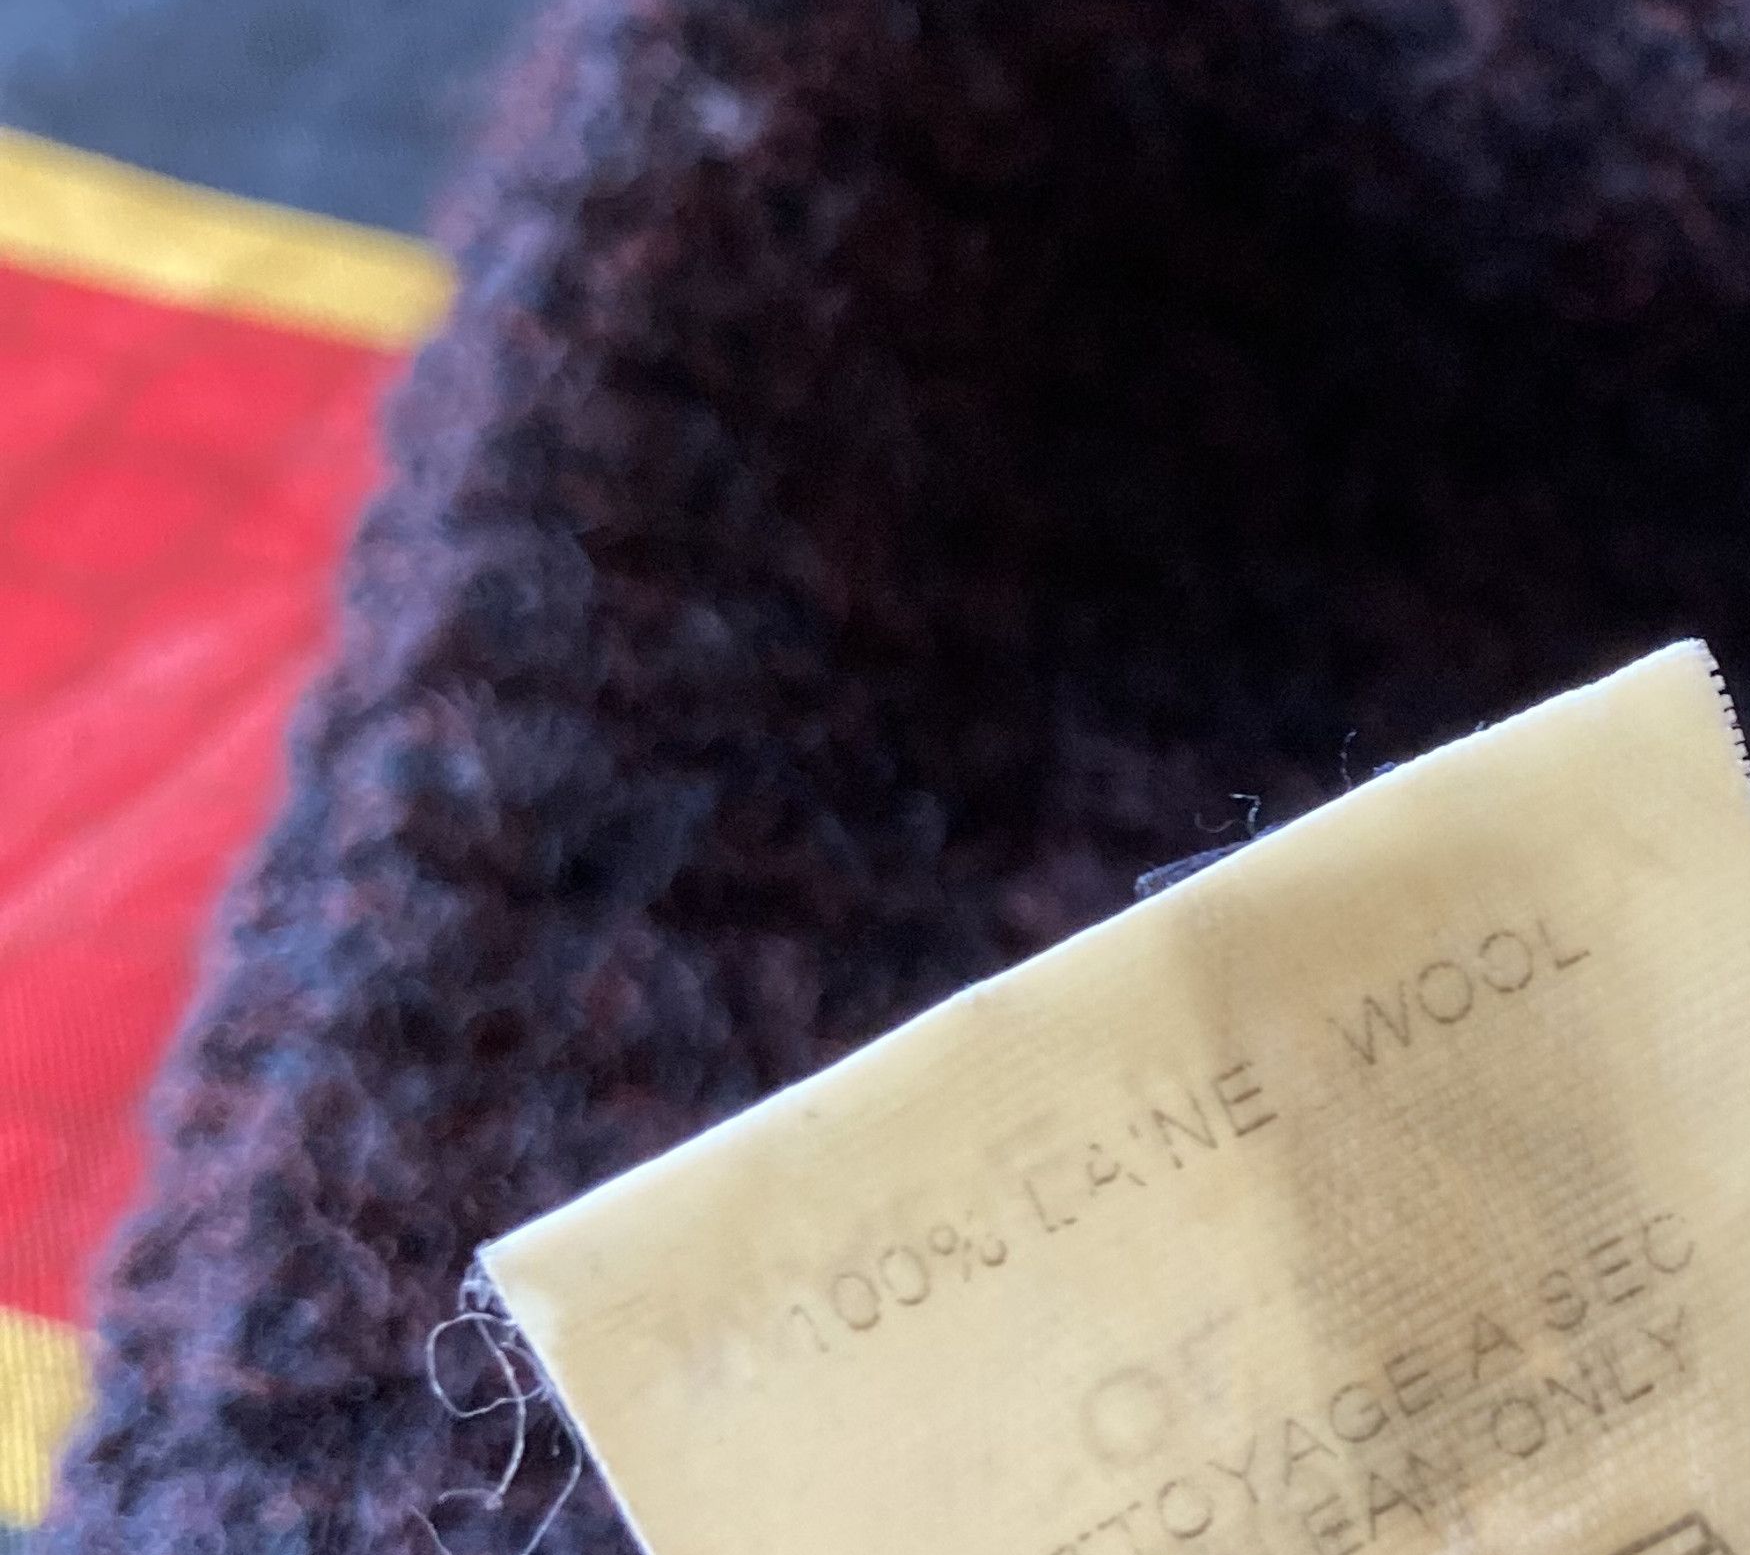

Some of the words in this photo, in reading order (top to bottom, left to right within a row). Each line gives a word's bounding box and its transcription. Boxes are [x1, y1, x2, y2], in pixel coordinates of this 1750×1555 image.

[1024, 1061, 1278, 1232] LANE
[1335, 918, 1591, 1066] WOOL
[1471, 1312, 1524, 1380] A
[1543, 1211, 1698, 1331] SEC
[1489, 1305, 1695, 1458] ONLY
